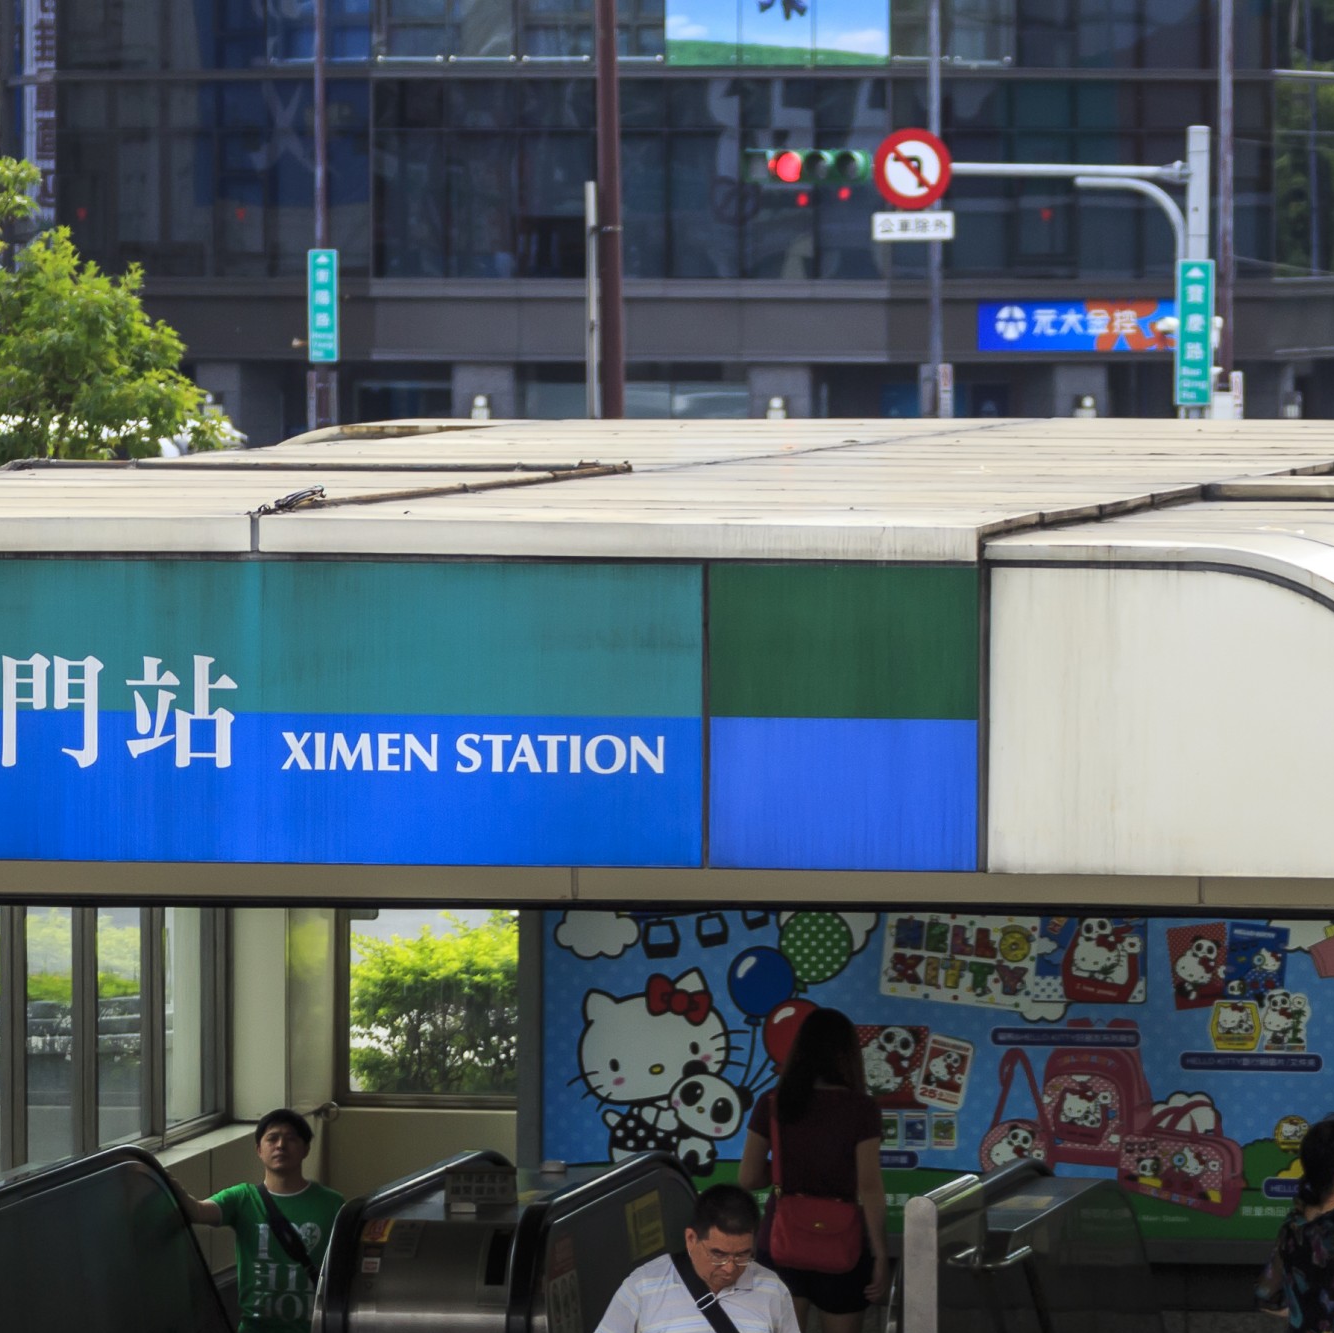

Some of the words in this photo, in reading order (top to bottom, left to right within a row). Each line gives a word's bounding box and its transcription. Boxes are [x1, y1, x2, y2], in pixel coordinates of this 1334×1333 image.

[1032, 308, 1138, 336] 元大金控
[280, 732, 440, 774] XIMEN
[454, 733, 667, 777] STATION
[894, 916, 1031, 962] HELLO
[887, 953, 1030, 996] KITTY
